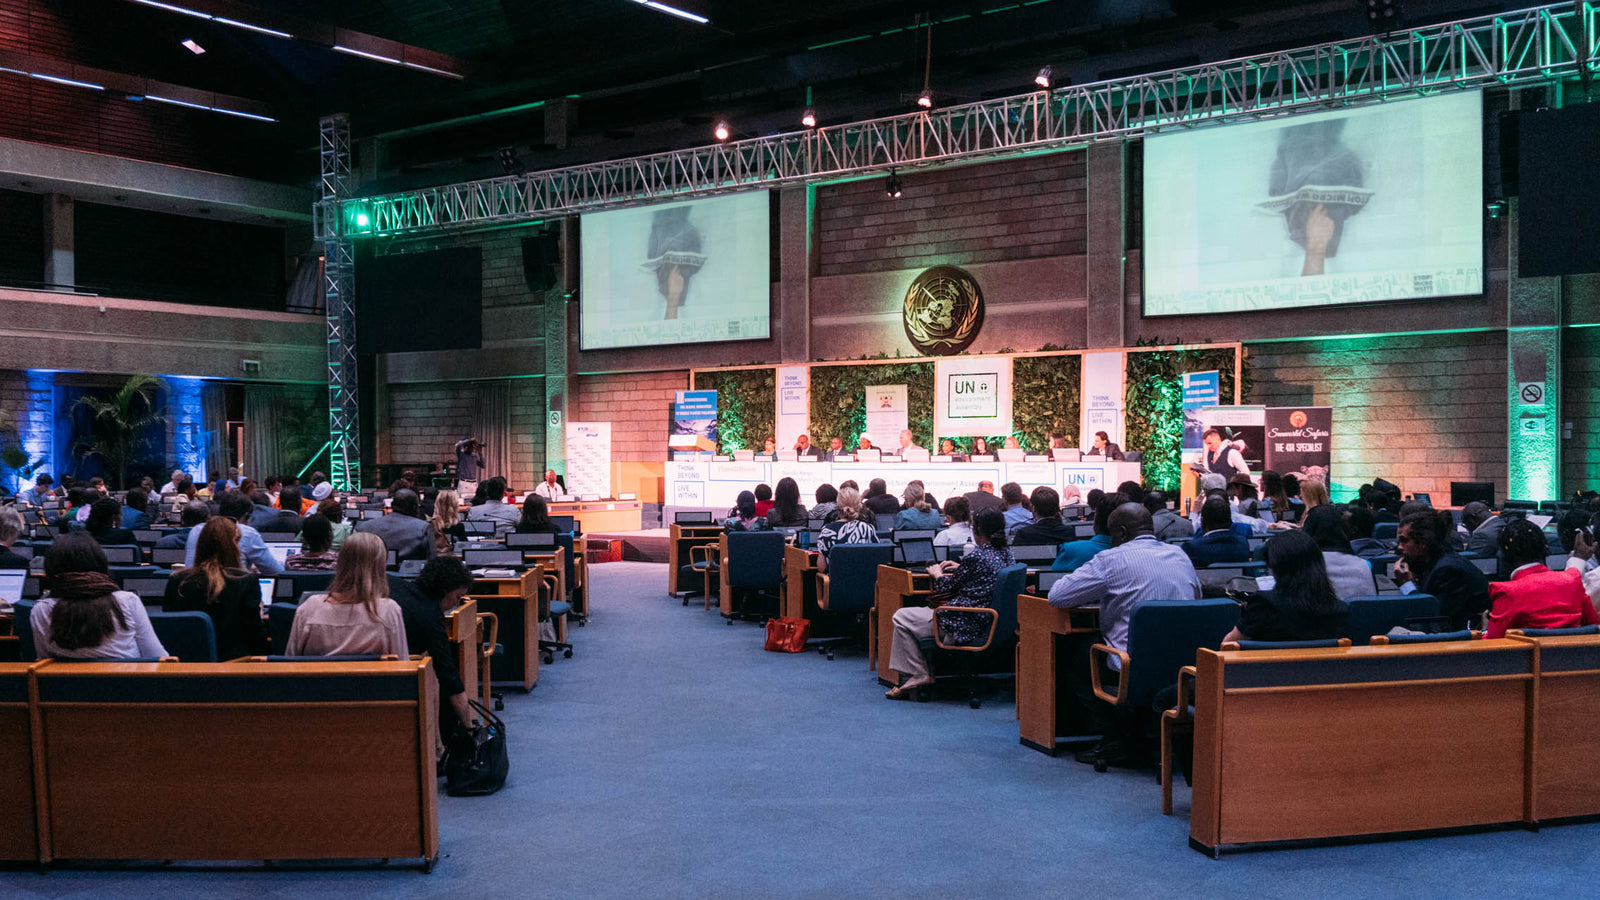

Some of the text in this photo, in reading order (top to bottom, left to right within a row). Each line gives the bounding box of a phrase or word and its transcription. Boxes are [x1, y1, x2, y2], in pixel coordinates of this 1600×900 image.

[955, 380, 975, 394] UN
[1092, 400, 1115, 408] BEYOND
[1274, 443, 1284, 452] THE
[1296, 442, 1323, 452] SPECIALIST
[1067, 473, 1086, 485] UN
